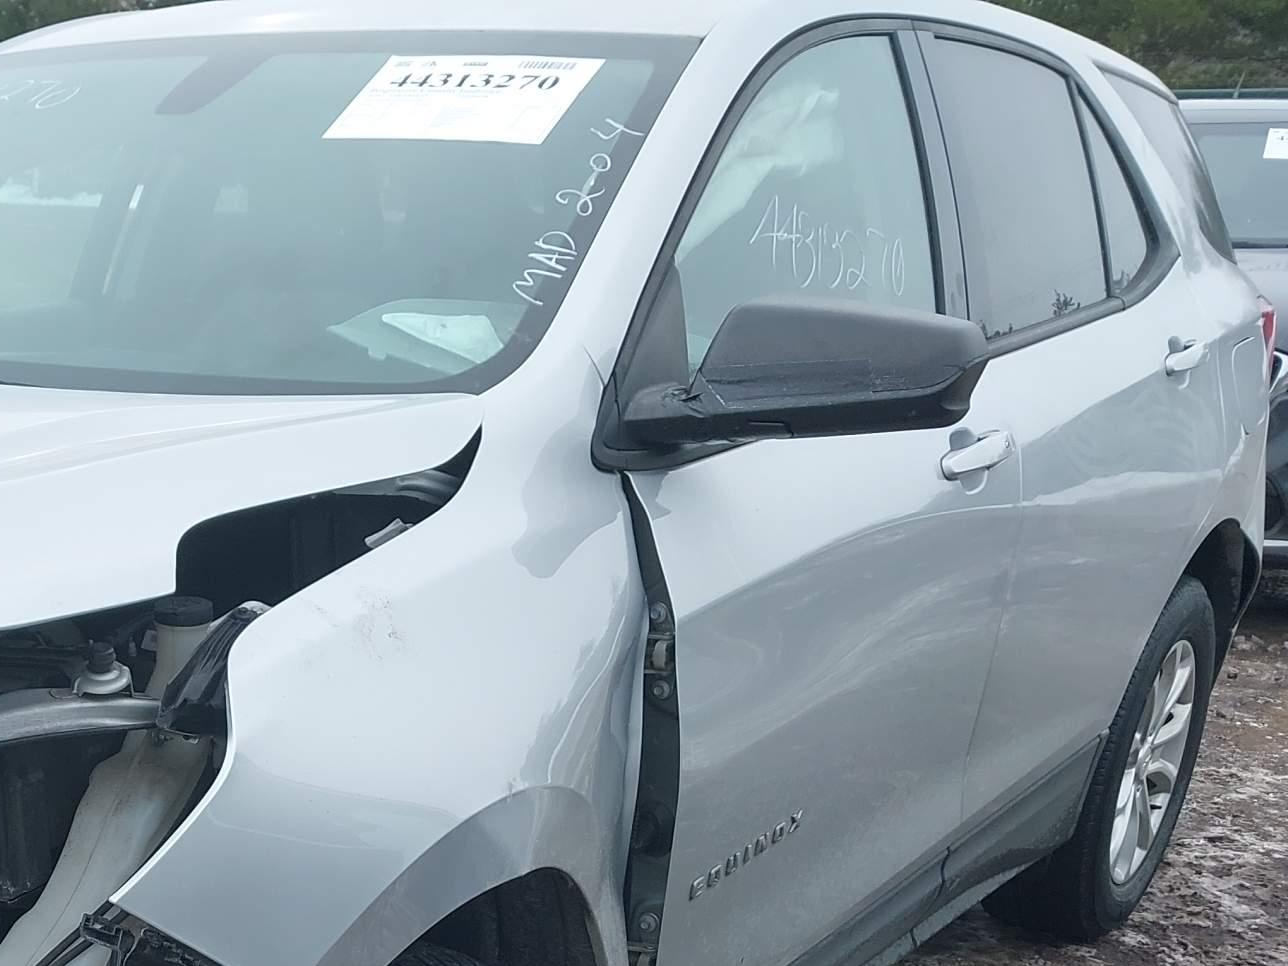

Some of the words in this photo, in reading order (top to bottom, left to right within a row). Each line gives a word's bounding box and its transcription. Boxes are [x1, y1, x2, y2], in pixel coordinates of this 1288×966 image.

[389, 72, 561, 90] 44313270
[512, 230, 578, 306] MAD
[688, 808, 805, 902] EQUINOX
